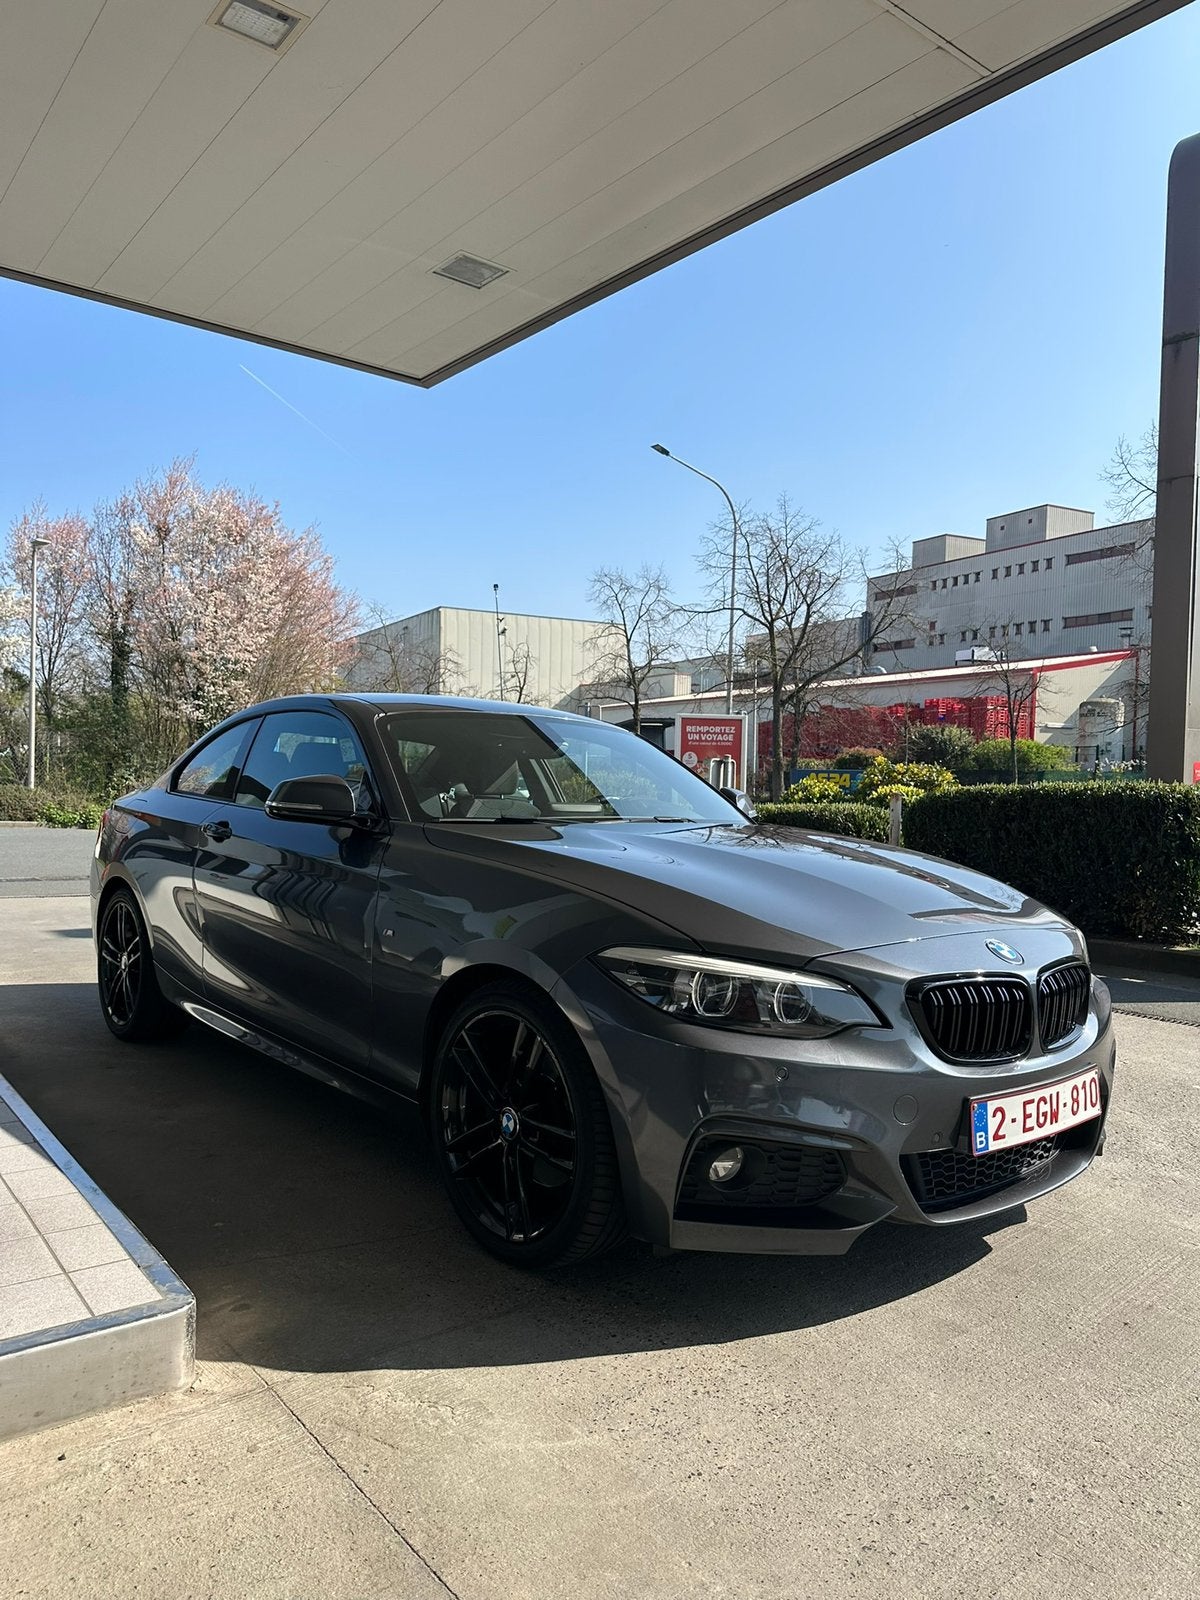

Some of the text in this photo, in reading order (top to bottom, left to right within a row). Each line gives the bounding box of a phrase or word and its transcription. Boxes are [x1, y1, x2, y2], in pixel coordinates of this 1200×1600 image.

[686, 725, 736, 733] REMPORTEZ
[687, 733, 734, 741] UN VOYAGE
[991, 1076, 1099, 1142] 2-EGW-810
[976, 1131, 987, 1149] B
